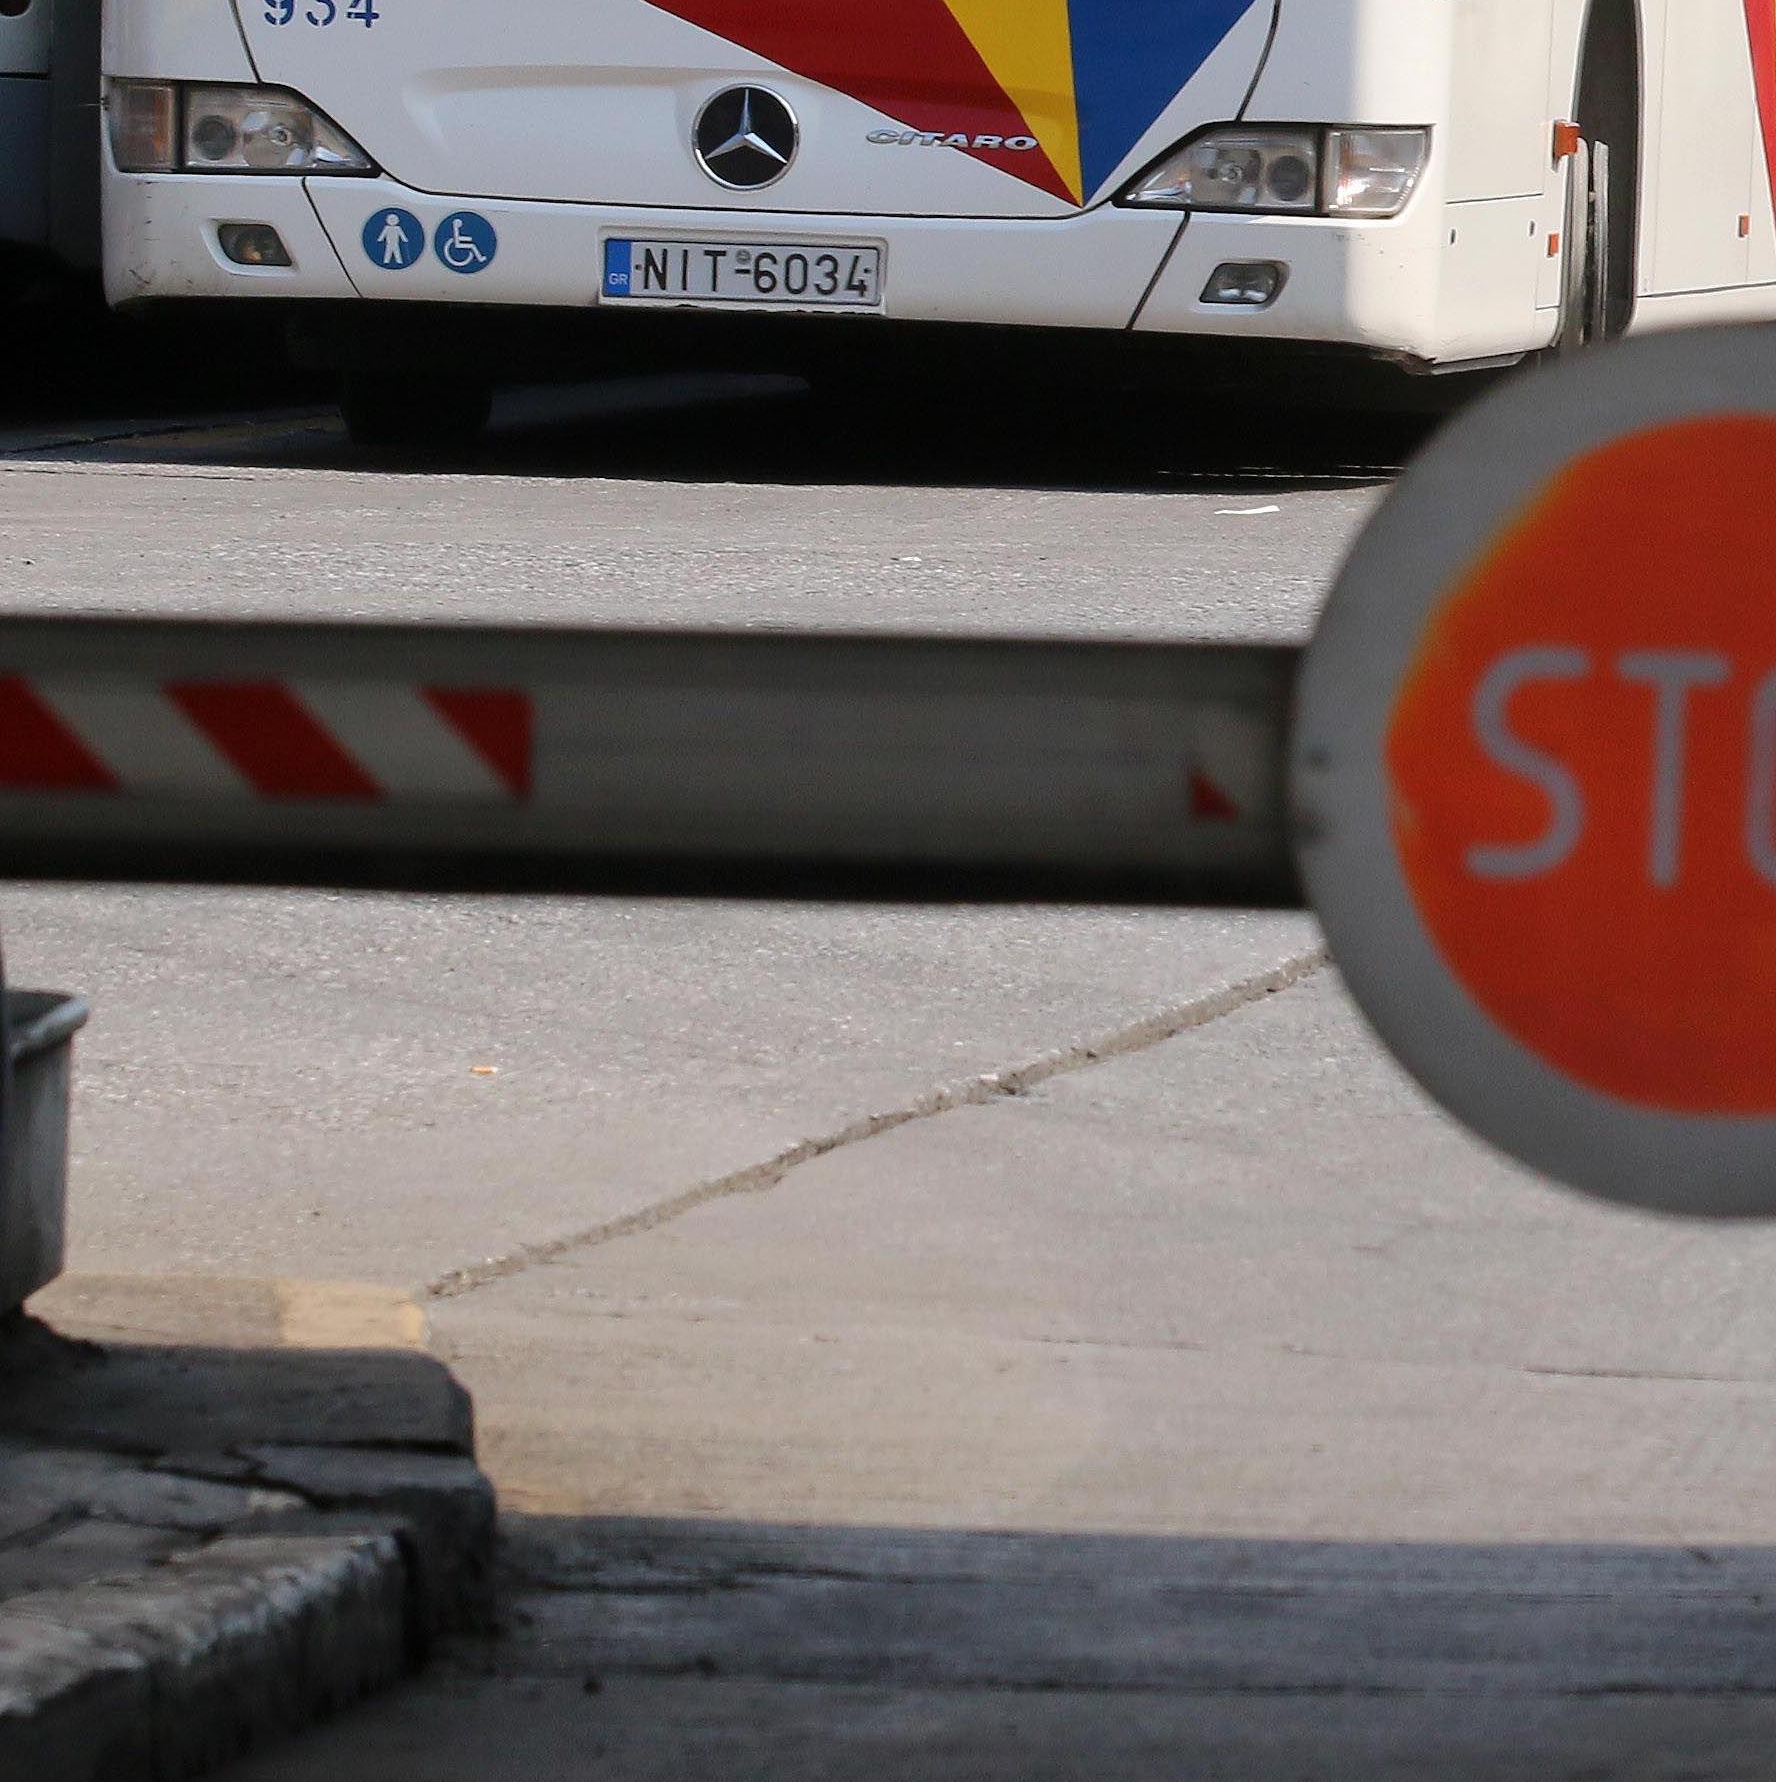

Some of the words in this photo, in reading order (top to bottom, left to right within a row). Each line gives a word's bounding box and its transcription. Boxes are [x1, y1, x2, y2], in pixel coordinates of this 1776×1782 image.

[866, 129, 1039, 150] CITARO
[608, 272, 628, 285] GR
[643, 247, 868, 298] NIT-6034
